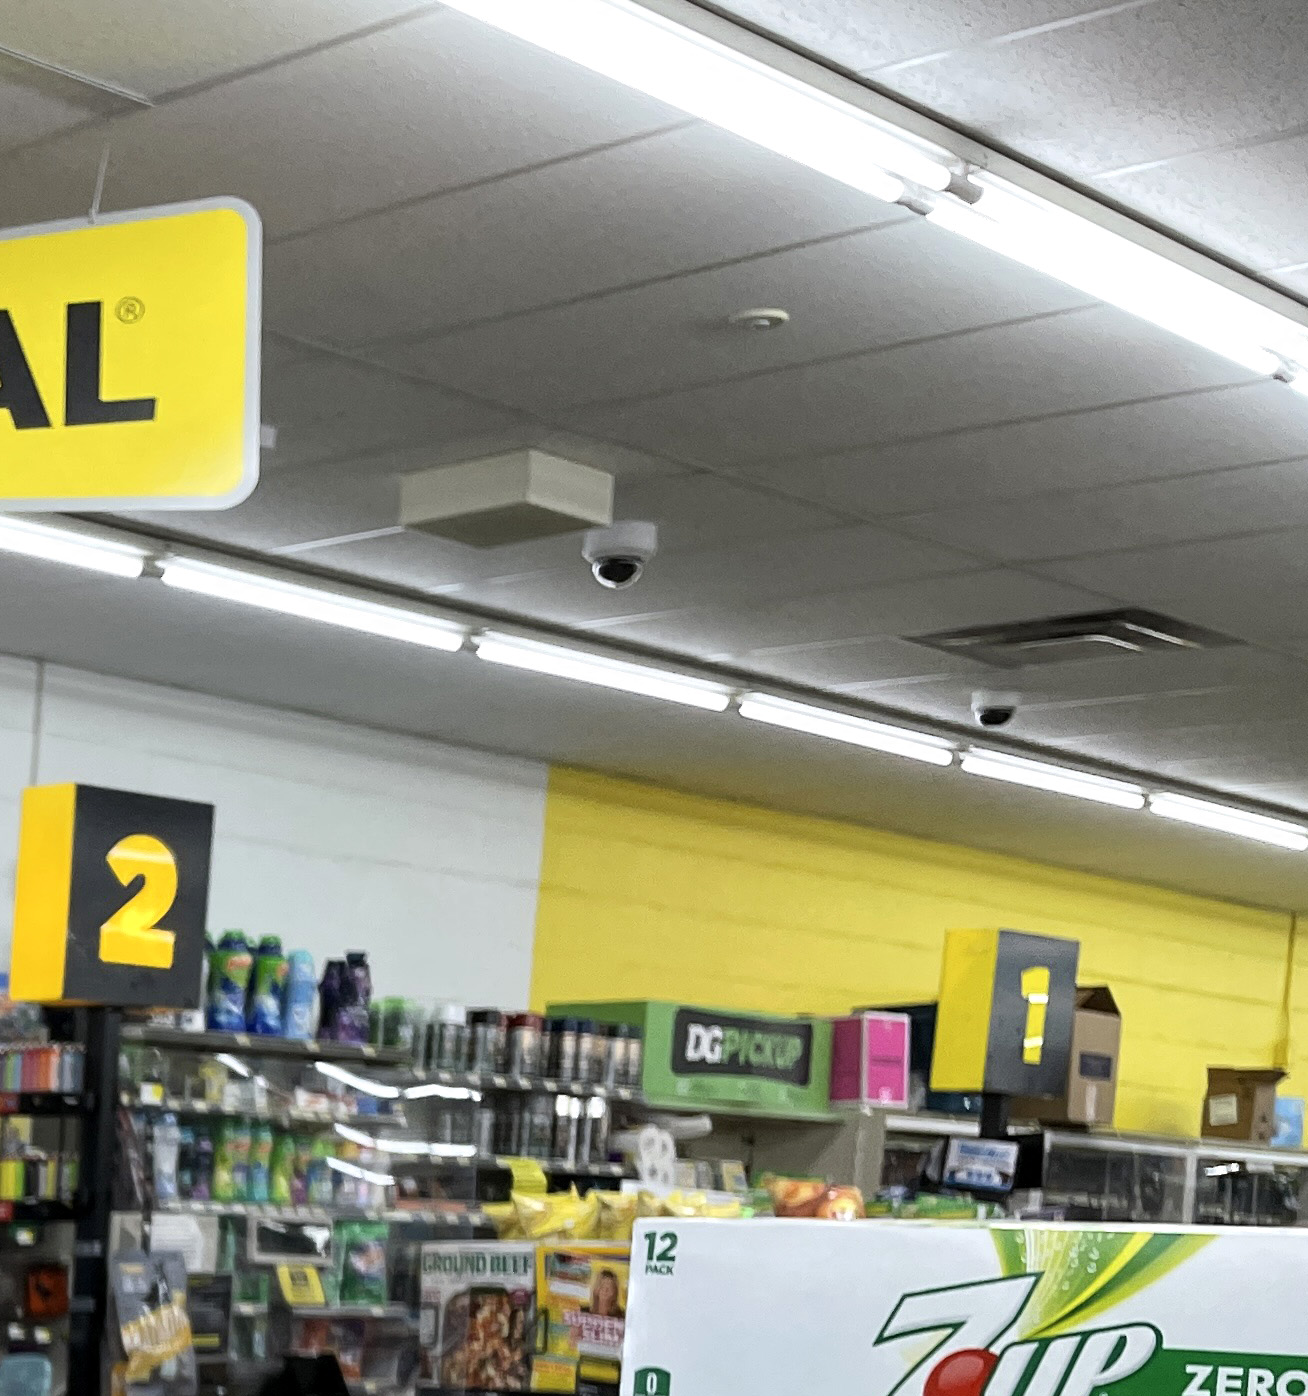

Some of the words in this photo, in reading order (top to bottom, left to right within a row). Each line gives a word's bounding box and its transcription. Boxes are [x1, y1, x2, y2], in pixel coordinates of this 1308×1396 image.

[99, 834, 178, 968] 2
[1021, 967, 1050, 1064] 1
[644, 1231, 678, 1262] 12
[423, 1252, 486, 1275] GROUND
[645, 1263, 674, 1277] PACK
[646, 1372, 657, 1395] 0
